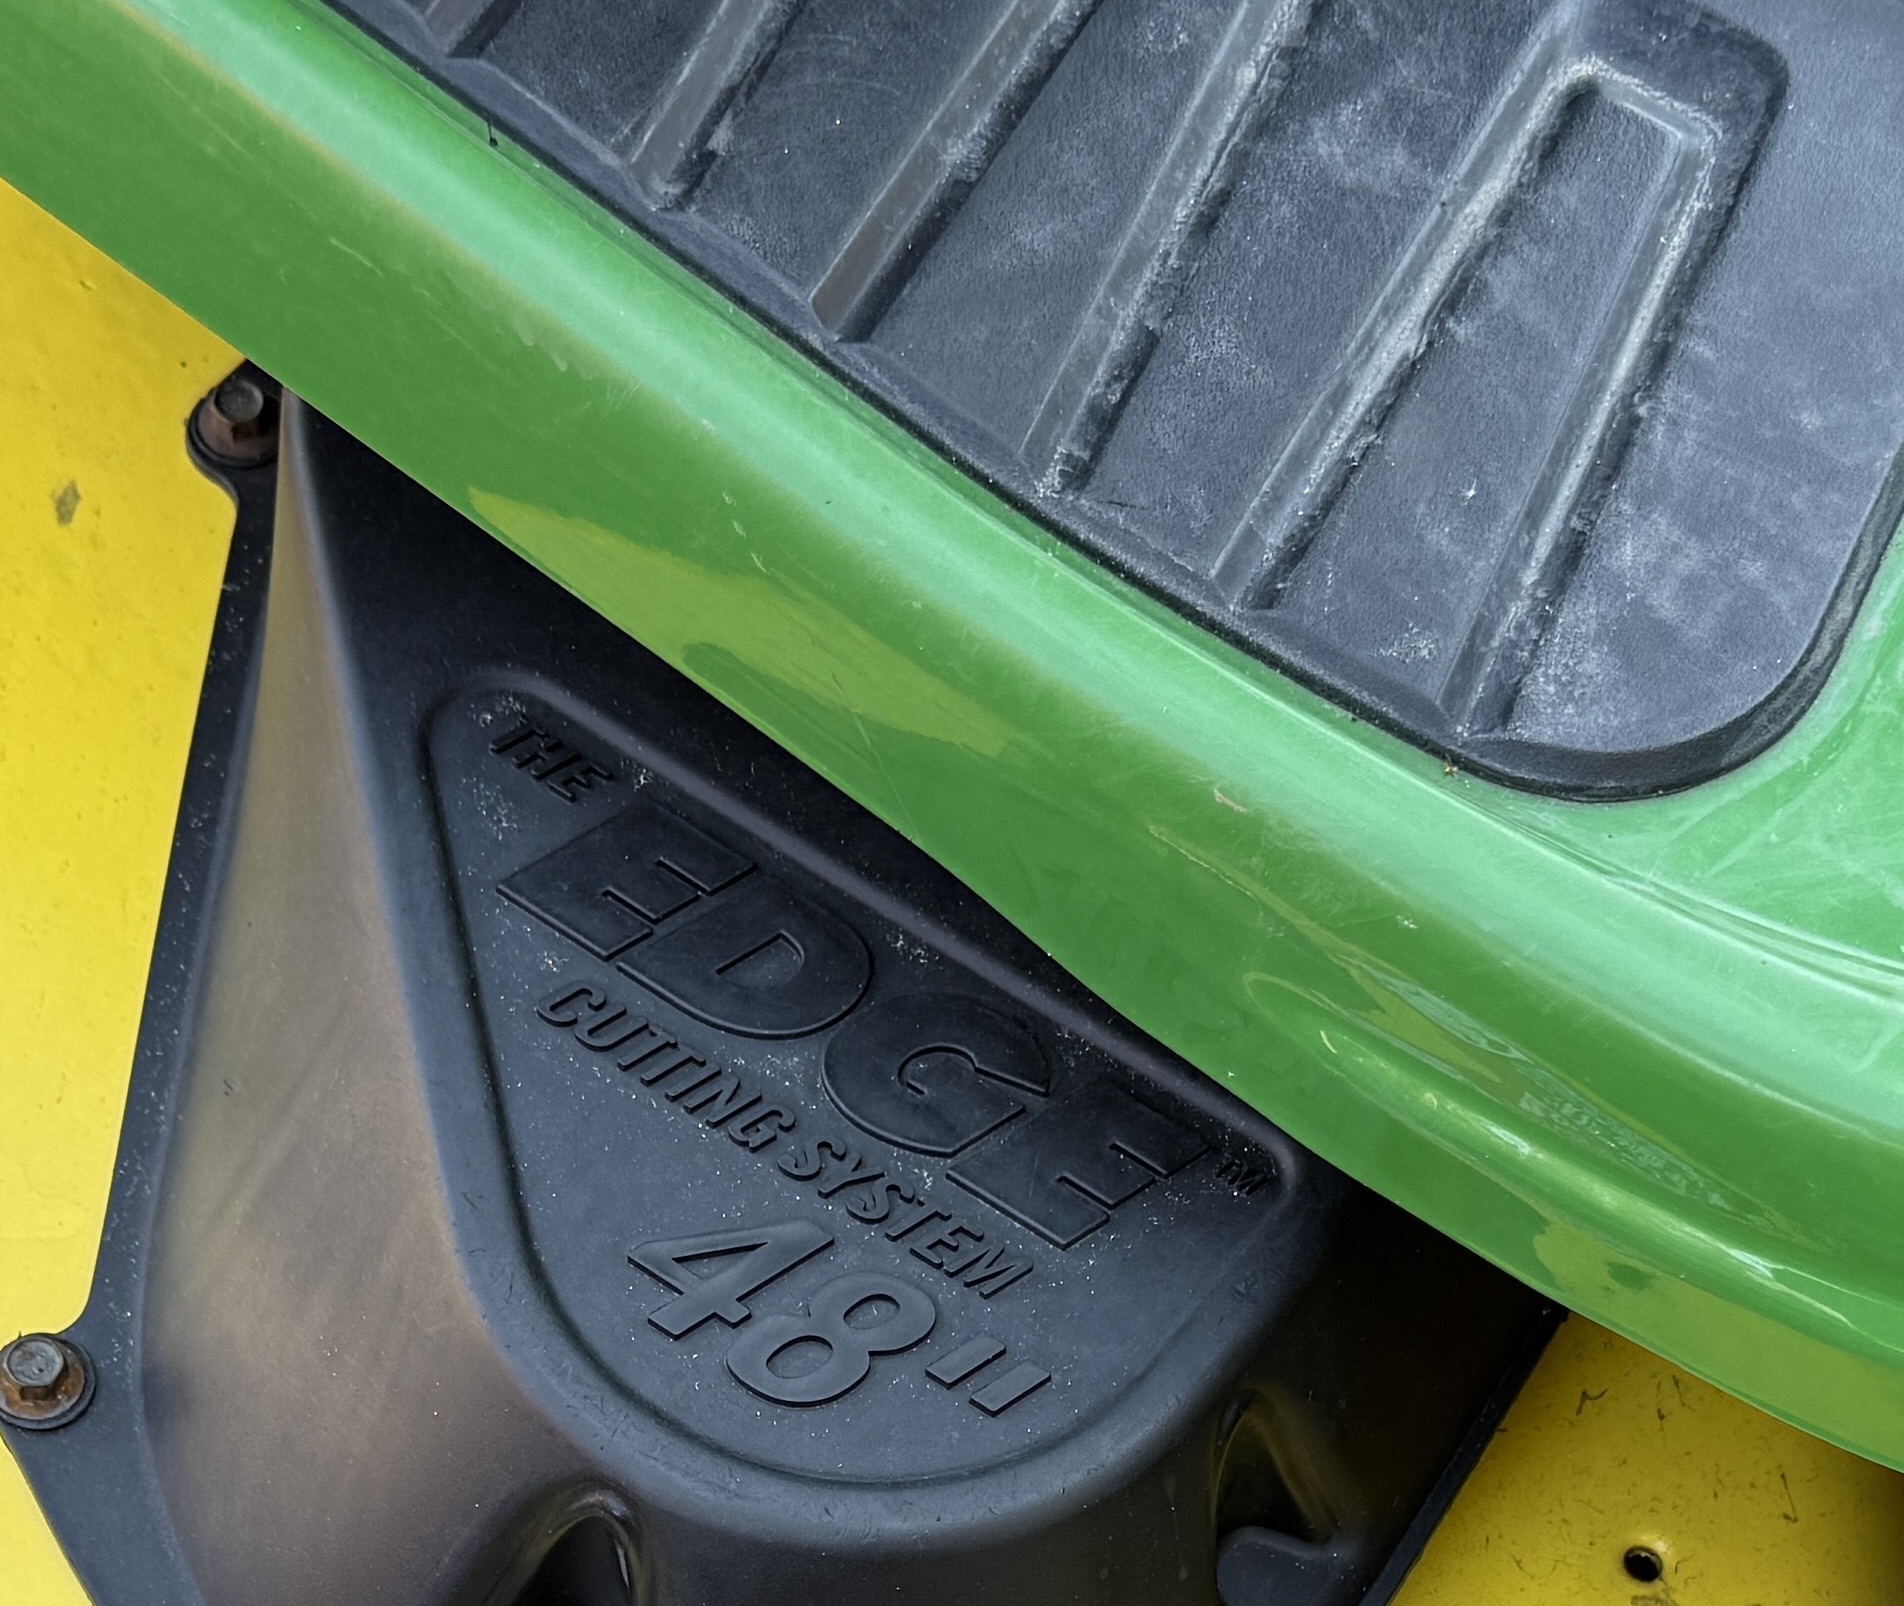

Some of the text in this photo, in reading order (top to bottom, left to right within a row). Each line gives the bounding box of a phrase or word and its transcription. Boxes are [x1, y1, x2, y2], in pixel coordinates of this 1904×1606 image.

[489, 712, 615, 802] THE
[497, 806, 1215, 1250] EDGE
[536, 979, 1036, 1300] CUTTING SYSTEM
[627, 1219, 1052, 1418] 48"
